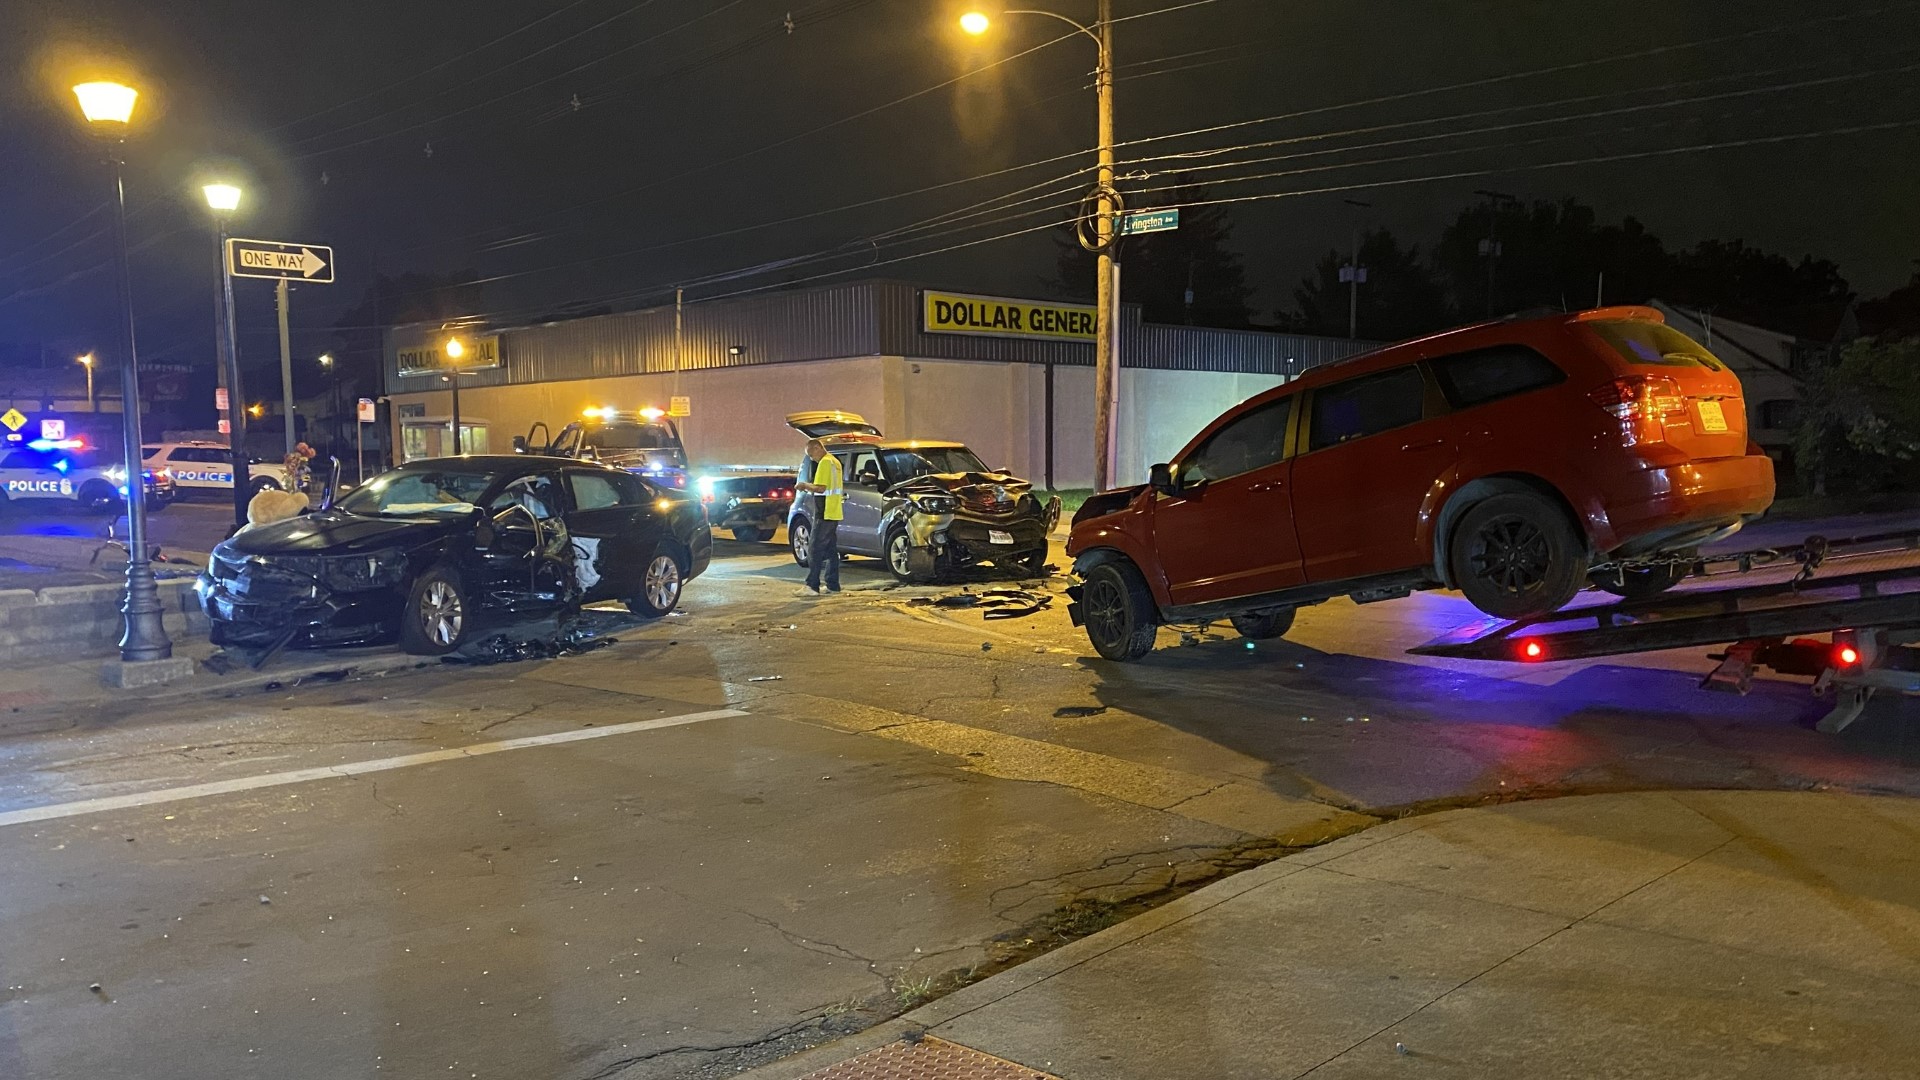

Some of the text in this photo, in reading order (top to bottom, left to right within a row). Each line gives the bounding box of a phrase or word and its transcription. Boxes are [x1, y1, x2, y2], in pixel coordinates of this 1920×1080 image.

[244, 252, 305, 269] ONE WAY
[935, 300, 1098, 334] DOLLAR GENER
[399, 349, 440, 368] DOLLAR
[177, 470, 226, 482] POLICE
[9, 480, 58, 492] POLICE
